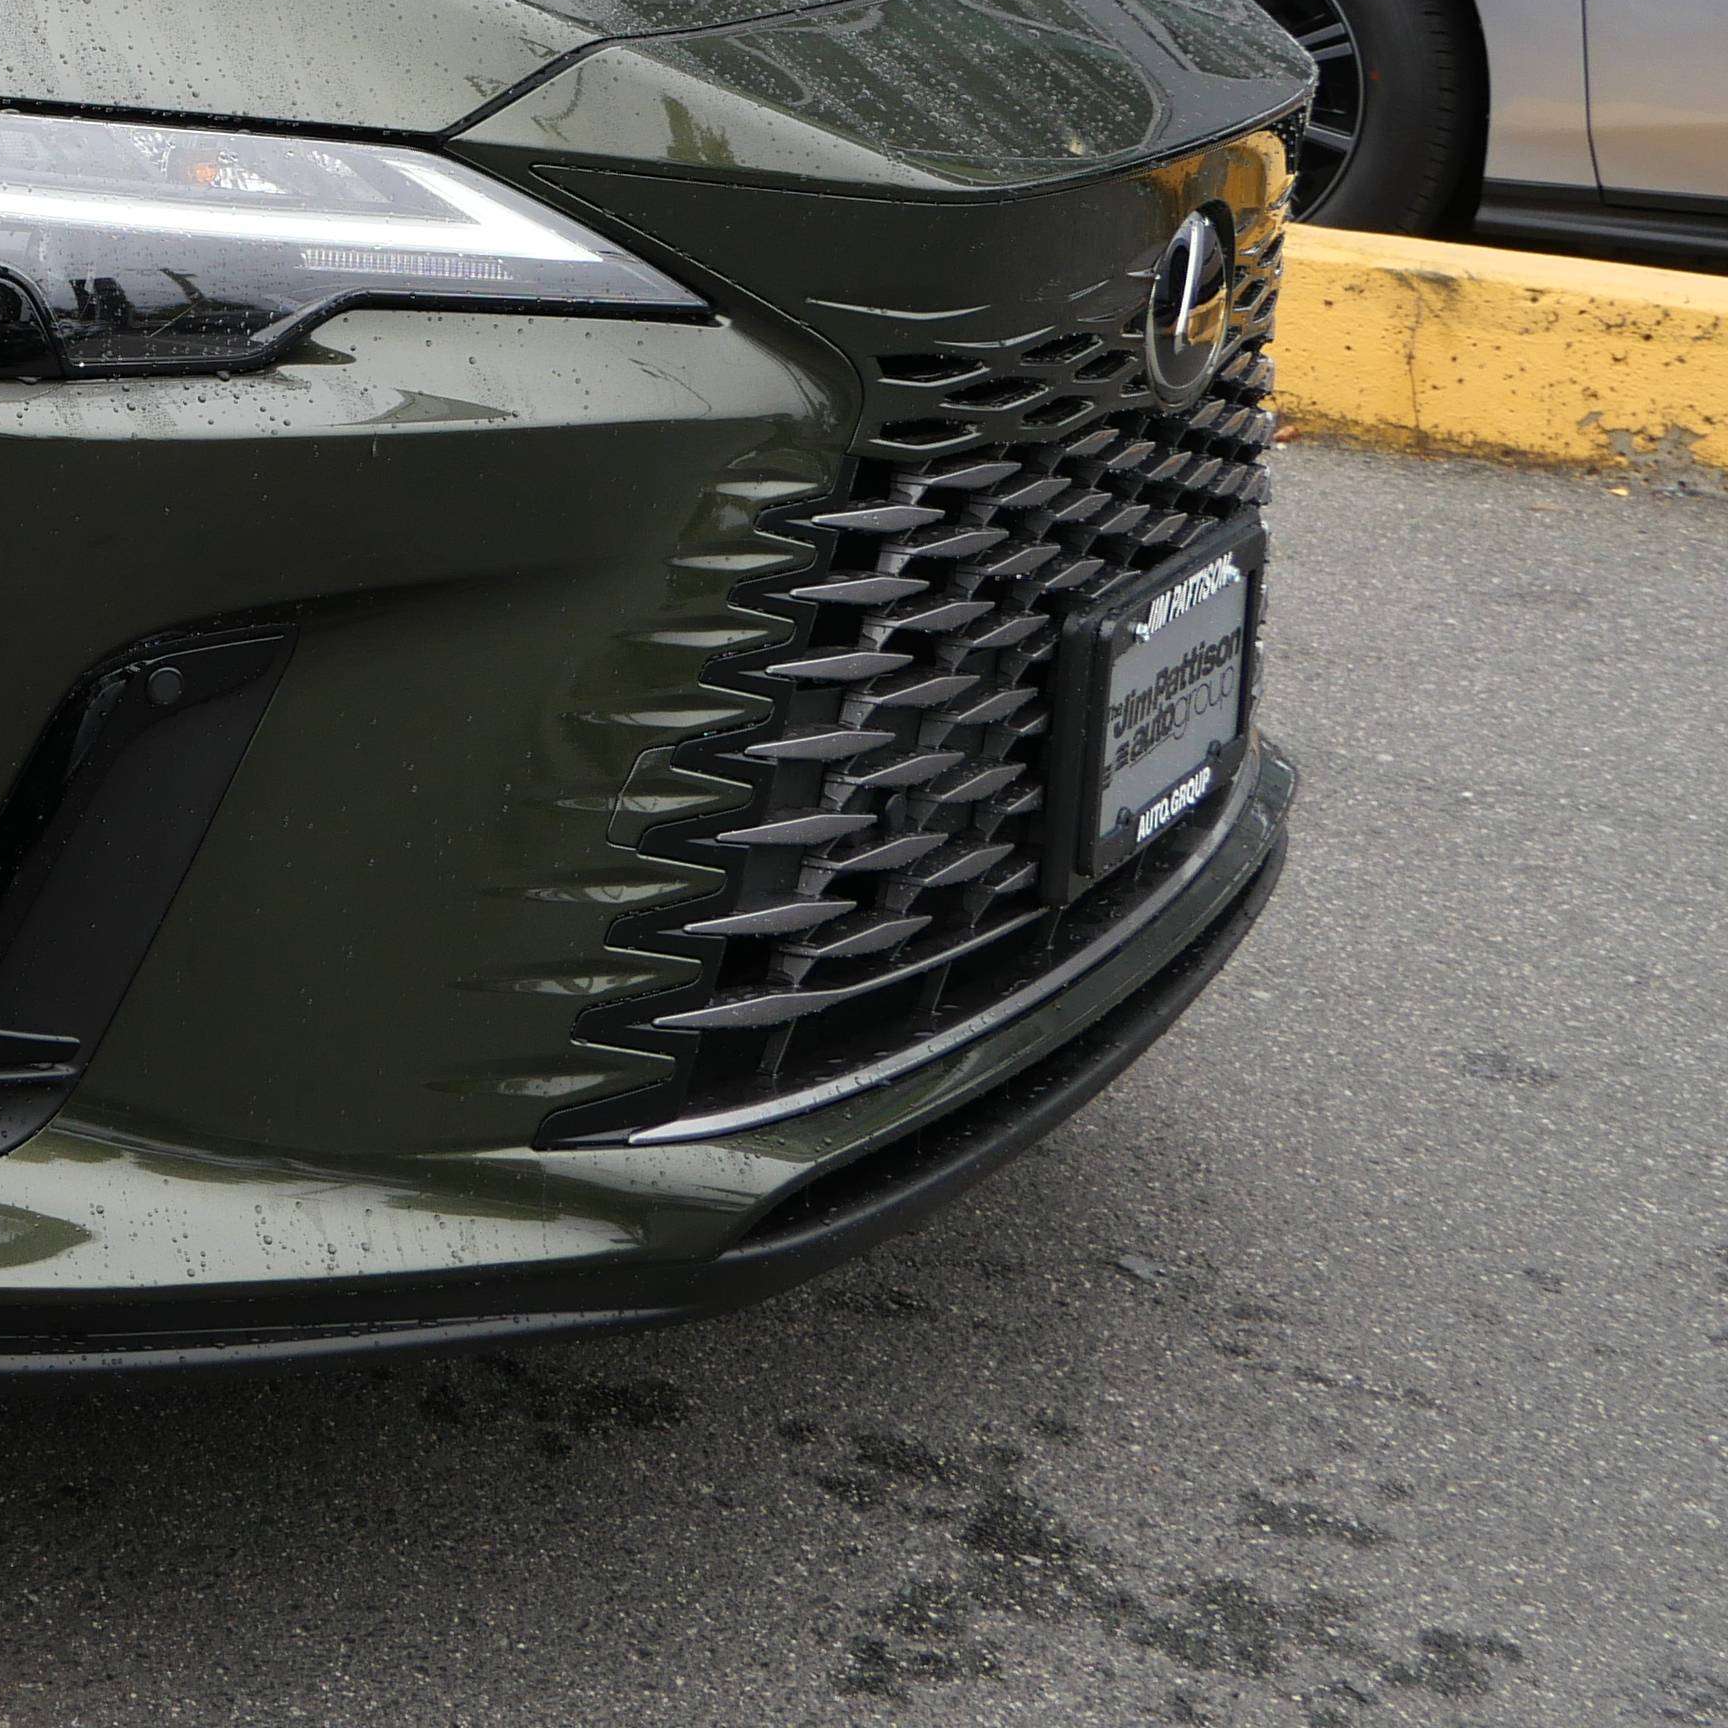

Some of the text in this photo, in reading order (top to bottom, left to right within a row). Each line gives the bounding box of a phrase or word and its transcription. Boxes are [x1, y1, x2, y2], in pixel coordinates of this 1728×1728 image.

[1147, 551, 1234, 634] JIM PATTISON
[1170, 766, 1211, 816] GROUP
